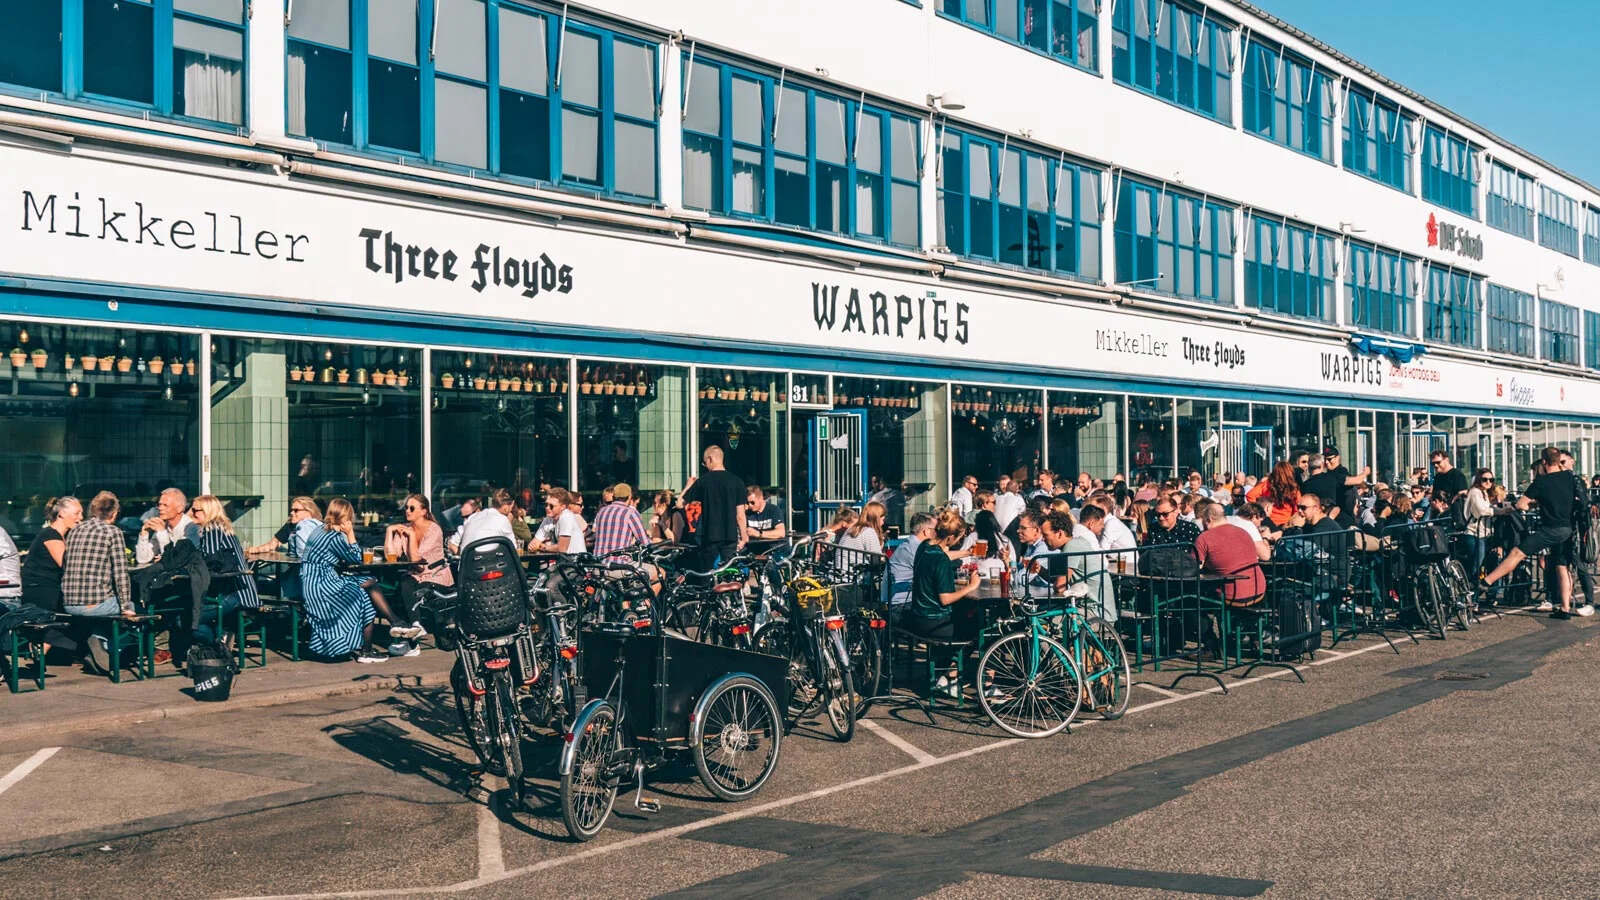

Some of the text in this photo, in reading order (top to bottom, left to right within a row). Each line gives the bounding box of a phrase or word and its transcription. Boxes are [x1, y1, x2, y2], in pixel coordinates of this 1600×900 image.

[21, 190, 310, 262] Mikkeller
[358, 227, 458, 284] Three
[811, 281, 970, 346] WARPIGS
[1096, 329, 1169, 358] Mikkeller
[1181, 336, 1211, 365] Three
[1320, 352, 1382, 387] WARPIGS
[792, 384, 809, 402] 31
